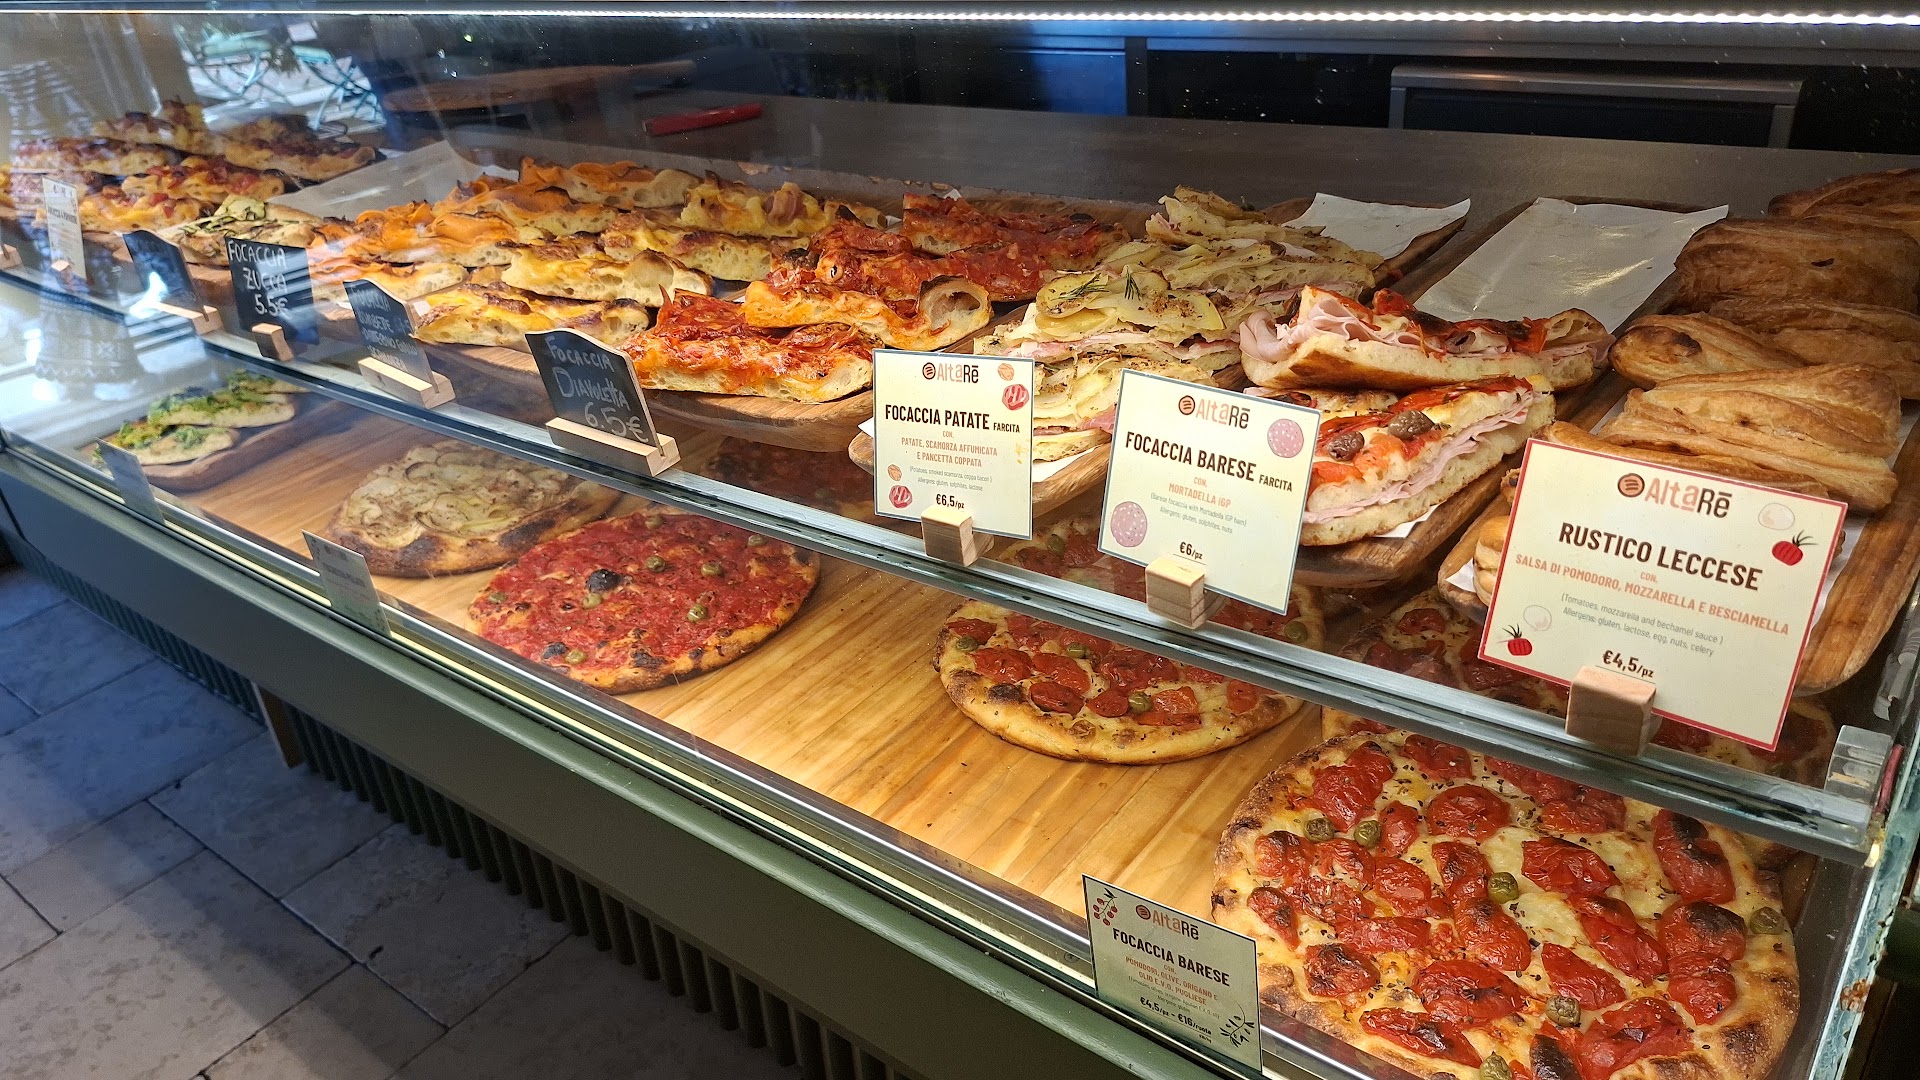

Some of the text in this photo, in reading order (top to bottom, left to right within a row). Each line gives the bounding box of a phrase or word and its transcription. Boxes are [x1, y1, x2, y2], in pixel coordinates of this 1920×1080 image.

[228, 240, 288, 270] FOCACCIA
[243, 267, 288, 293] ZUCCA
[255, 294, 292, 319] 5.5€
[544, 335, 615, 373] FOCACCIA
[552, 366, 631, 411] DIAVOLETTA
[585, 402, 649, 443] 6.5€
[885, 404, 1020, 433] FOCACCIA PATATE FARCITA
[901, 437, 998, 456] PATATE, SCAMORZA AFFUMICATA
[916, 452, 982, 468] E PANCETTA COPPATA
[1125, 431, 1293, 492] FOCACCIA BARESE FARCITA
[936, 494, 965, 509] €6,5/pz
[1169, 483, 1231, 508] MORTADELLA IGP
[1179, 541, 1203, 560] €6/pz
[1558, 522, 1763, 592] RUSTICO LECCESE
[1515, 553, 1790, 636] SALSA DI POMODORO, MOZZARELLA E BESCIAMELLA
[1561, 593, 1599, 610] (Tomatoes,
[1600, 605, 1640, 621] mozzarella
[1641, 615, 1656, 626] and
[1656, 619, 1694, 636] bechamel
[1695, 631, 1718, 643] sauce
[1597, 616, 1621, 631] gluten,
[1623, 624, 1651, 638] lactose,
[1652, 633, 1669, 644] egg,
[1670, 637, 1688, 649] nuts,
[1690, 643, 1714, 657] celery
[1602, 649, 1654, 678] €4,5/pz
[1112, 928, 1230, 987] FOCACCIA BARESE
[1139, 971, 1153, 983] OLIO
[1175, 987, 1207, 1006] PUGLIESE
[1160, 971, 1182, 986] OLIVE,
[1183, 980, 1212, 998] ORIGANO
